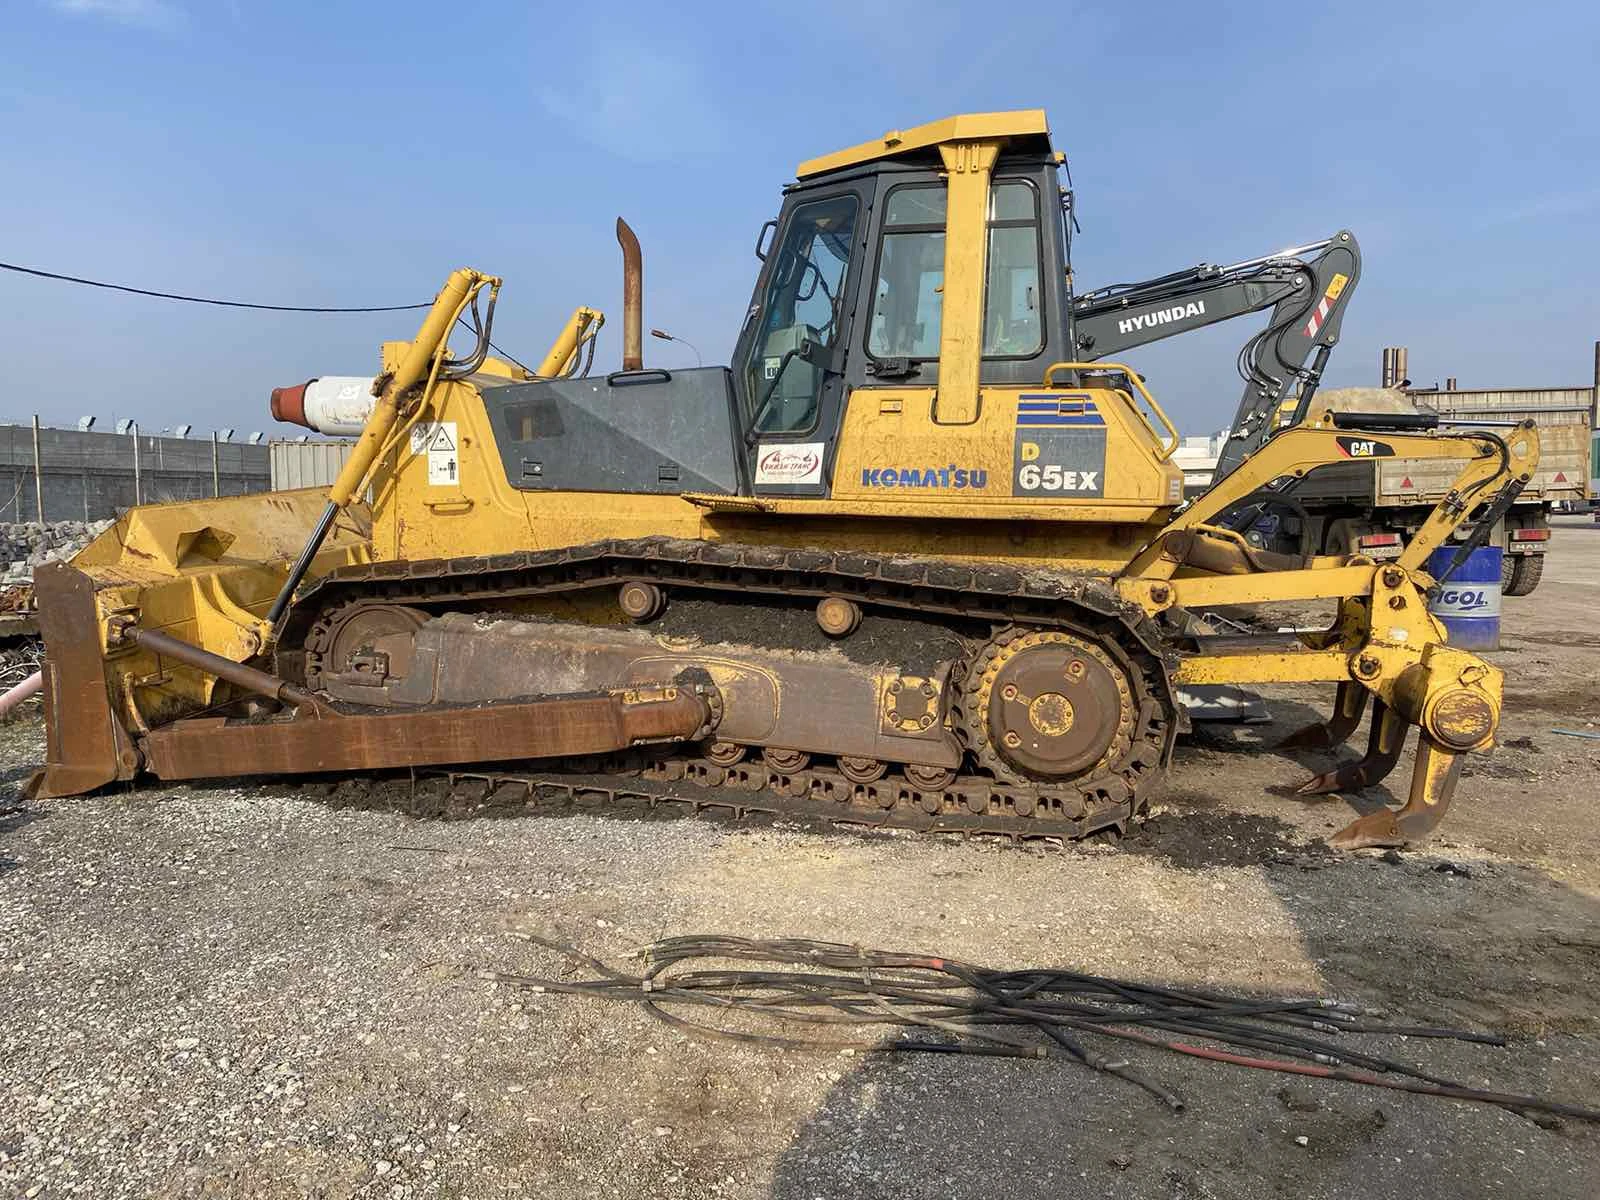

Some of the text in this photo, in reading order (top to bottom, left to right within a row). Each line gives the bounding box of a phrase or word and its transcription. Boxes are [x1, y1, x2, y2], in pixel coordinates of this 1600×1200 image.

[1118, 301, 1206, 334] HYUNDAI
[1021, 442, 1040, 461] D
[1351, 442, 1376, 456] CAT
[862, 464, 987, 488] KOMATSU
[1019, 464, 1098, 490] 65EX
